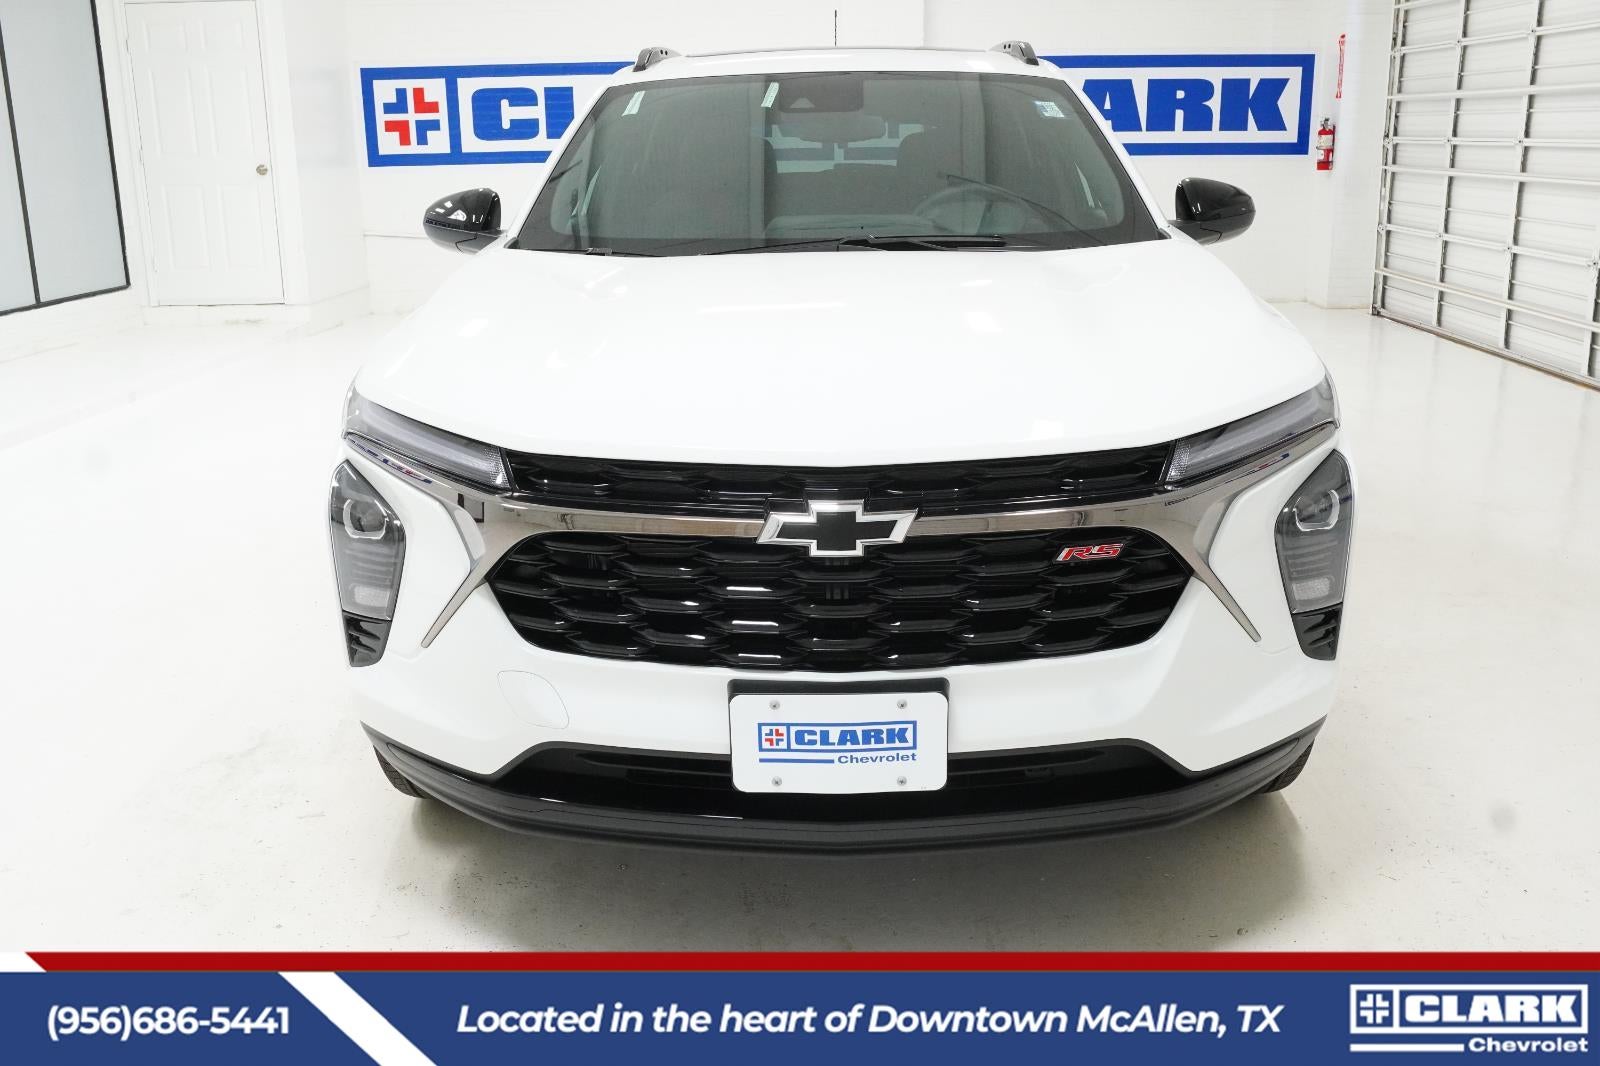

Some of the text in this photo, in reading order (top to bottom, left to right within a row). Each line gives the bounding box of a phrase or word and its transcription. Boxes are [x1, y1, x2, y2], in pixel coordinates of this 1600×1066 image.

[1056, 543, 1124, 561] RS
[794, 727, 909, 746] CLARK
[837, 752, 917, 764] Chevrolet
